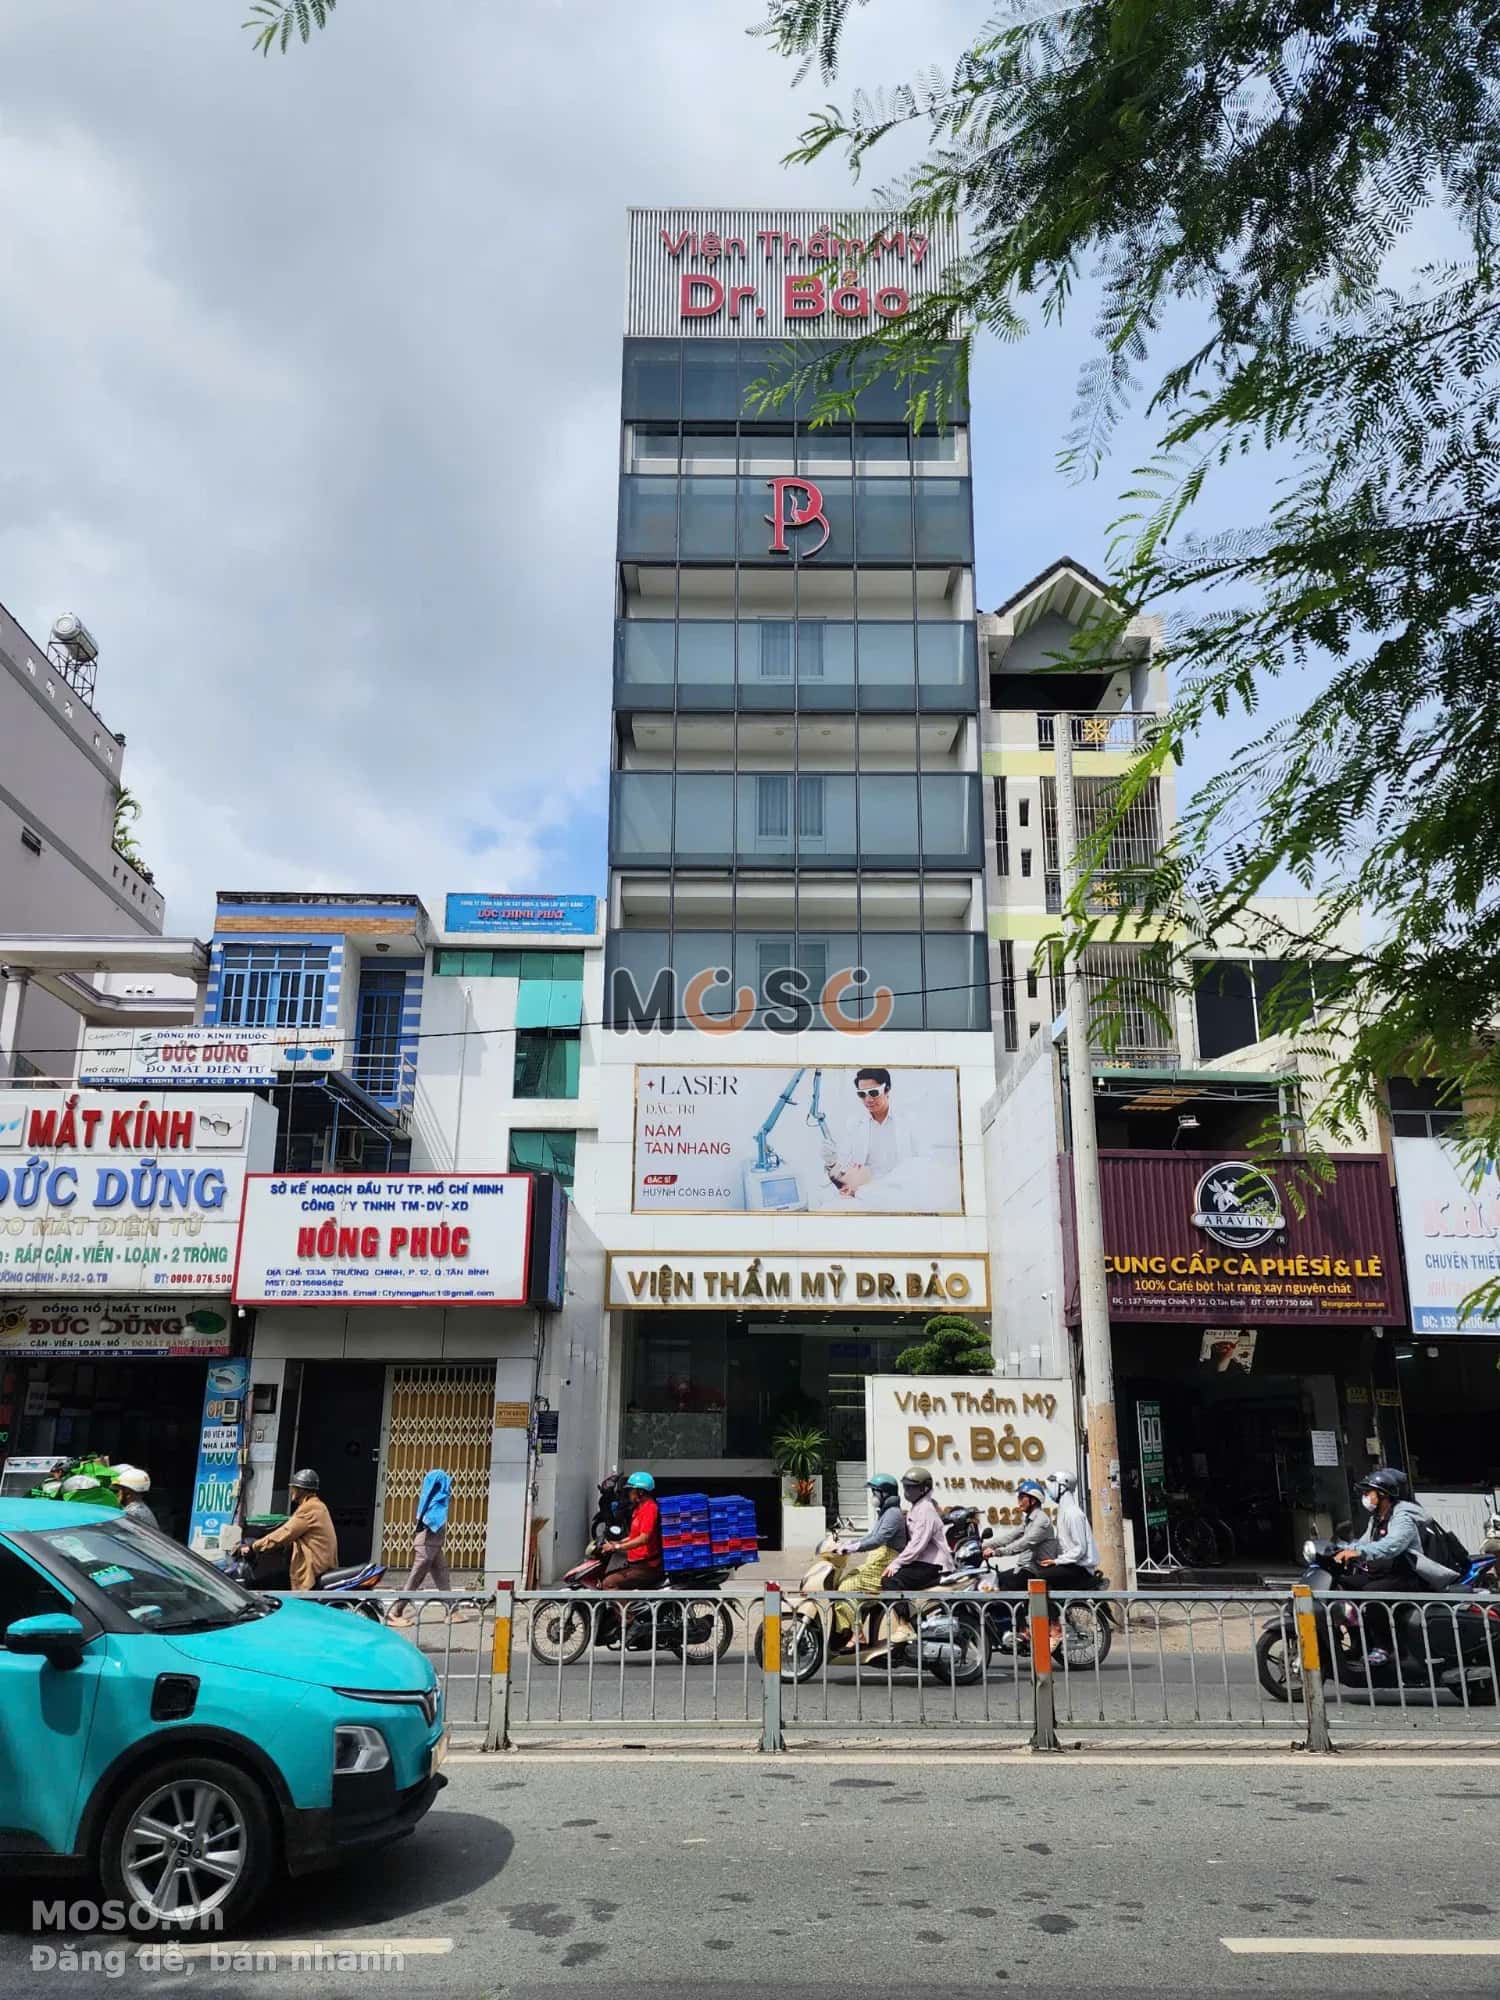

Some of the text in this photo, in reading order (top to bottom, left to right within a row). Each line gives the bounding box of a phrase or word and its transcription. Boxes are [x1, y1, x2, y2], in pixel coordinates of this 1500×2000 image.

[660, 224, 929, 266] Viện Thẩm Mỹ
[680, 270, 910, 320] Dr. Bảo
[162, 1039, 249, 1063] ĐỨC DŨNG
[661, 1075, 739, 1096] LASER
[27, 1094, 194, 1149] MẮT KÍNH
[645, 1121, 681, 1137] NÁM
[676, 1142, 731, 1155] NHANG
[92, 1158, 228, 1209] DŨNG
[270, 1180, 503, 1197] SỞ KẾ HOẠCH ĐẦU TƯ TP. HỒ CHÍ MINH
[301, 1200, 336, 1212] CÔNG
[363, 1202, 396, 1211] TNHH
[31, 1210, 91, 1237] MẮT
[97, 1215, 160, 1241] ĐIỆN
[296, 1217, 470, 1258] HỒNG PHÚC
[45, 1246, 73, 1268] CẬN
[125, 1247, 161, 1269] LOẠN
[172, 1248, 181, 1264] 2
[184, 1243, 228, 1264] TRÒNG
[1104, 1256, 1167, 1275] CUNG
[1171, 1249, 1222, 1275] CẤP
[1223, 1253, 1258, 1276] CÀ
[1333, 1262, 1353, 1278] &
[1355, 1255, 1383, 1278] LẺ
[1425, 1251, 1469, 1269] CHUYÊN
[25, 1271, 54, 1283] CHINH
[627, 1257, 971, 1305] VIỆN THẨM MỸ DR. BẢO
[1134, 1279, 1167, 1291] 100%
[1196, 1279, 1214, 1294] bột
[1216, 1281, 1234, 1295] hạt
[1237, 1282, 1262, 1296] rang
[1263, 1284, 1284, 1297] xay
[144, 1303, 176, 1313] KÍNH
[29, 1312, 89, 1335] ĐỨC
[895, 1388, 1057, 1420] Viện Thẩm Mỹ
[908, 1424, 1046, 1462] Dr. Bảo
